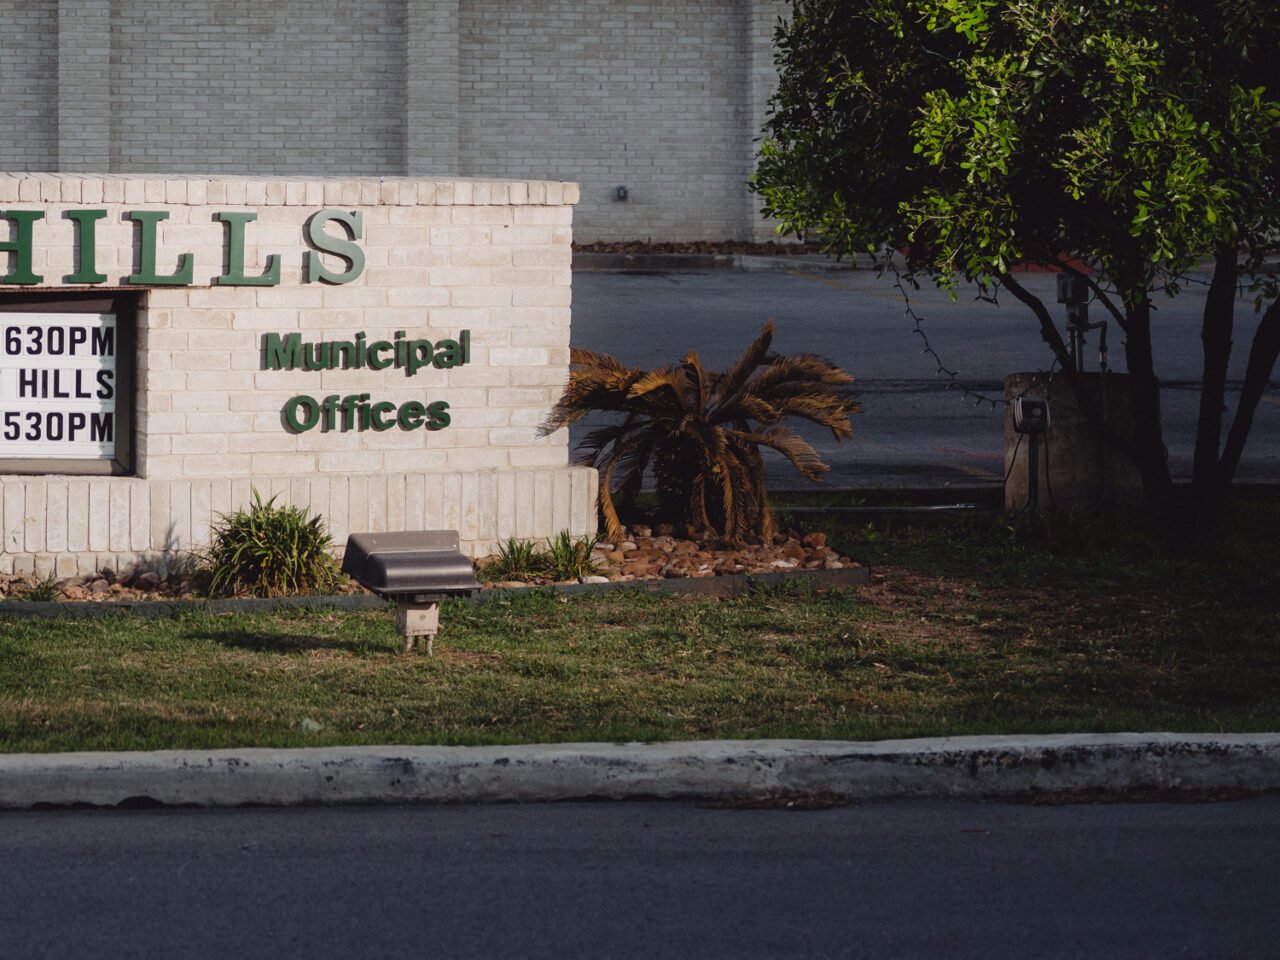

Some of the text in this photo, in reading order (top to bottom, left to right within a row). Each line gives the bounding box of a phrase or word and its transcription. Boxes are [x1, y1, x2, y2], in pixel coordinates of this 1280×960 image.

[5, 326, 114, 356] 630PM
[261, 329, 470, 376] Municipal
[19, 369, 114, 399] HILLS
[4, 412, 113, 442] 530PM
[284, 393, 451, 433] Offices
